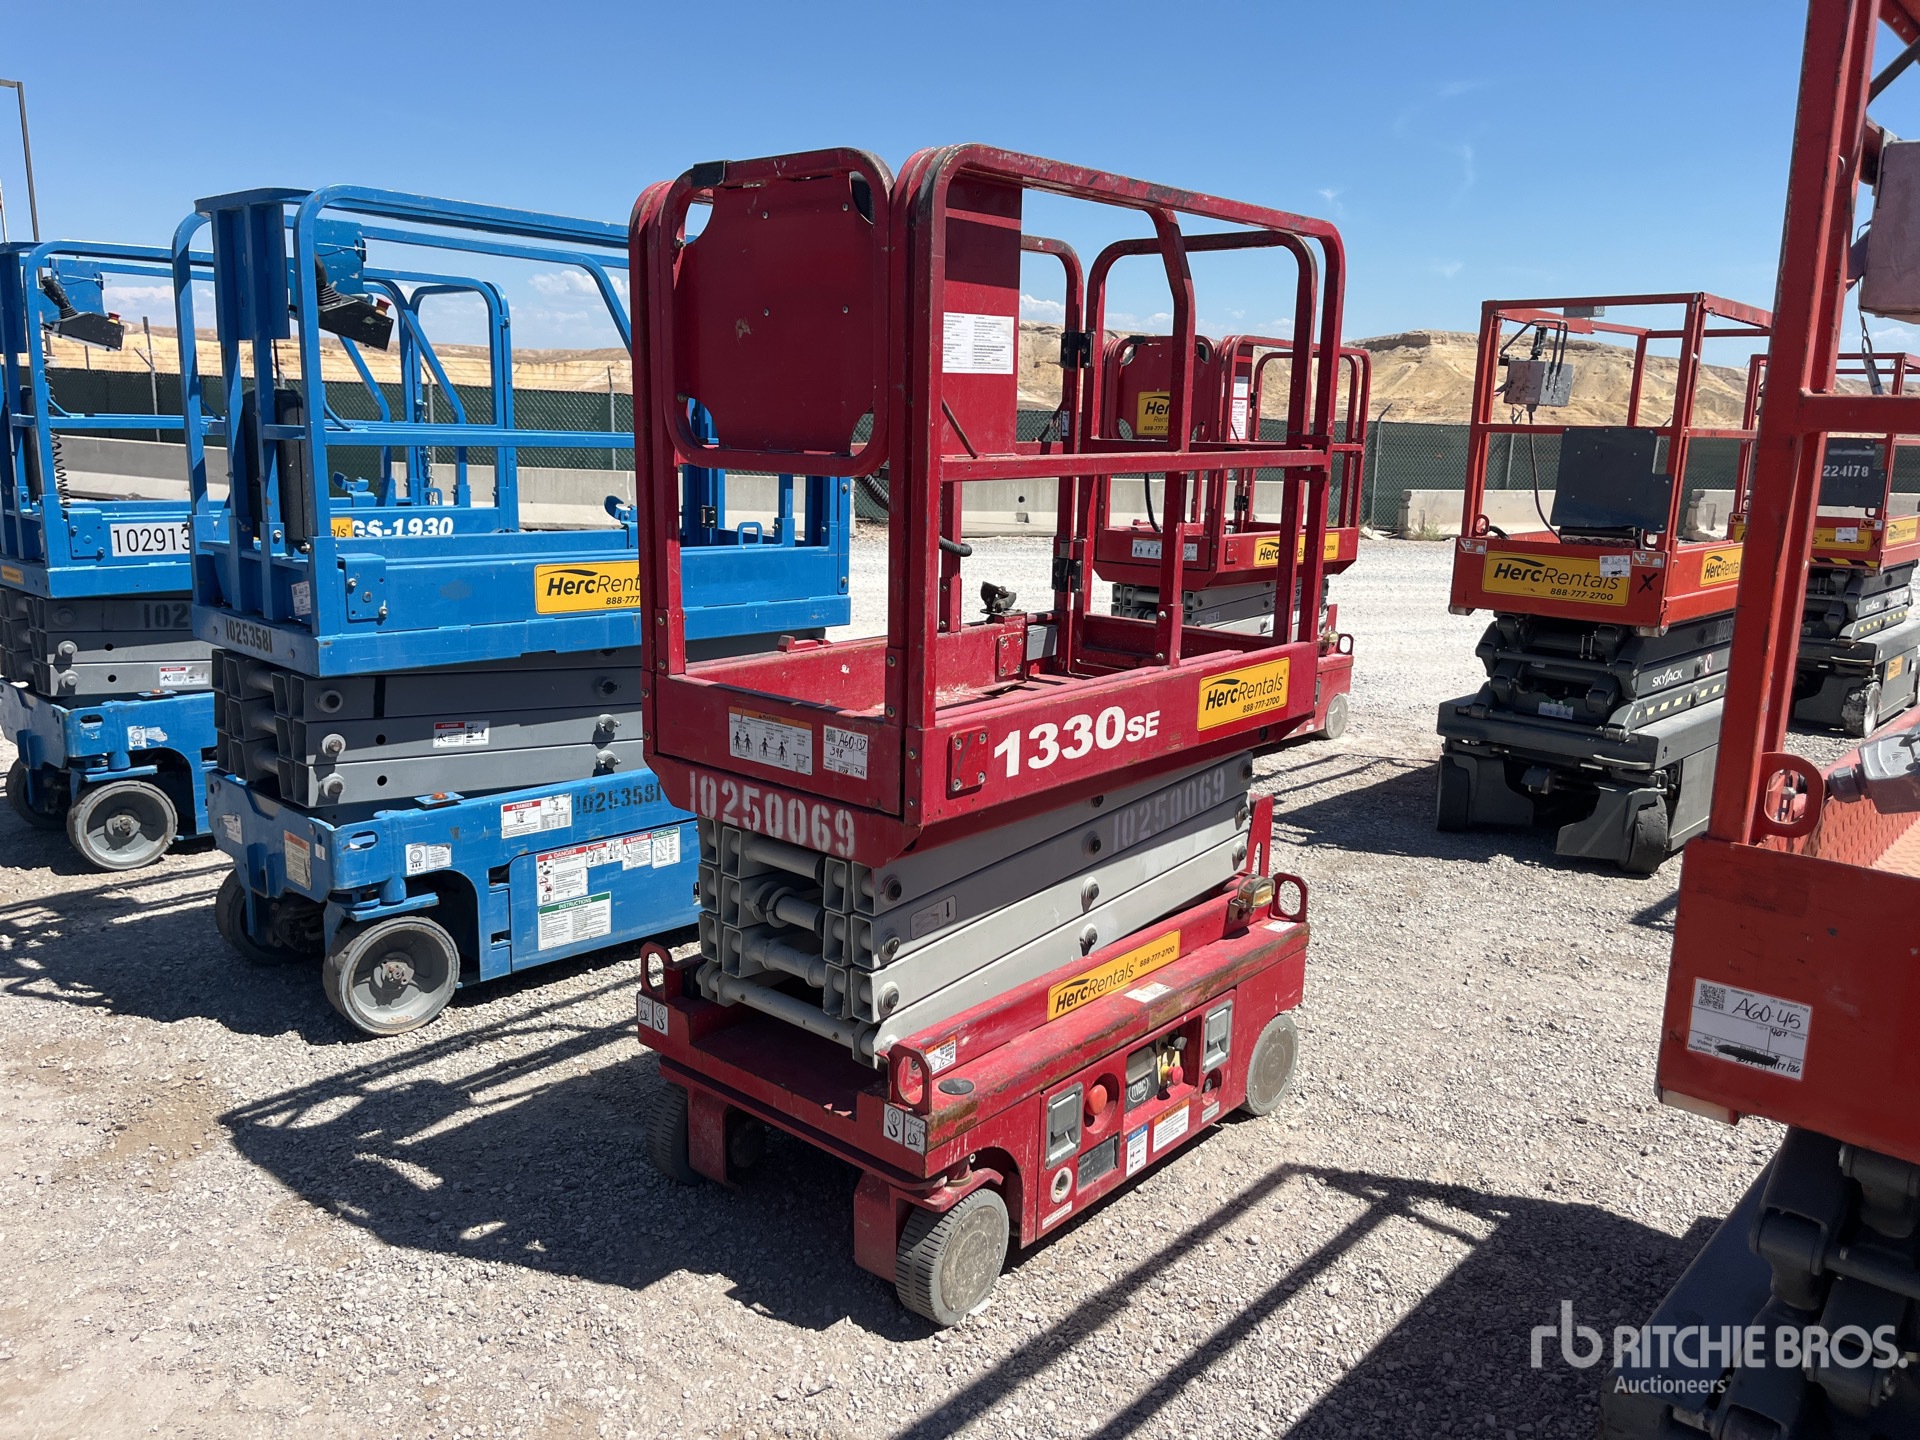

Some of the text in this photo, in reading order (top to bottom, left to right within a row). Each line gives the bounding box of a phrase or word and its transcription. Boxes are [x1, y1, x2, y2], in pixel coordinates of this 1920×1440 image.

[1822, 465, 1869, 477] 224178
[1494, 563, 1620, 590] HercRentals
[1550, 588, 1613, 600] 888-777-2700
[225, 618, 273, 653] 10253581
[1652, 668, 1683, 687] SKYJACK
[1205, 672, 1284, 711] HercRentals
[1242, 696, 1280, 713] 888-777-2700
[689, 770, 855, 857] 10250069
[1113, 767, 1225, 852] 10250069
[553, 849, 577, 858] DANGER
[558, 897, 592, 910] INSTRUCTIONS
[1055, 945, 1175, 1013] HercRentals 888-777-2700
